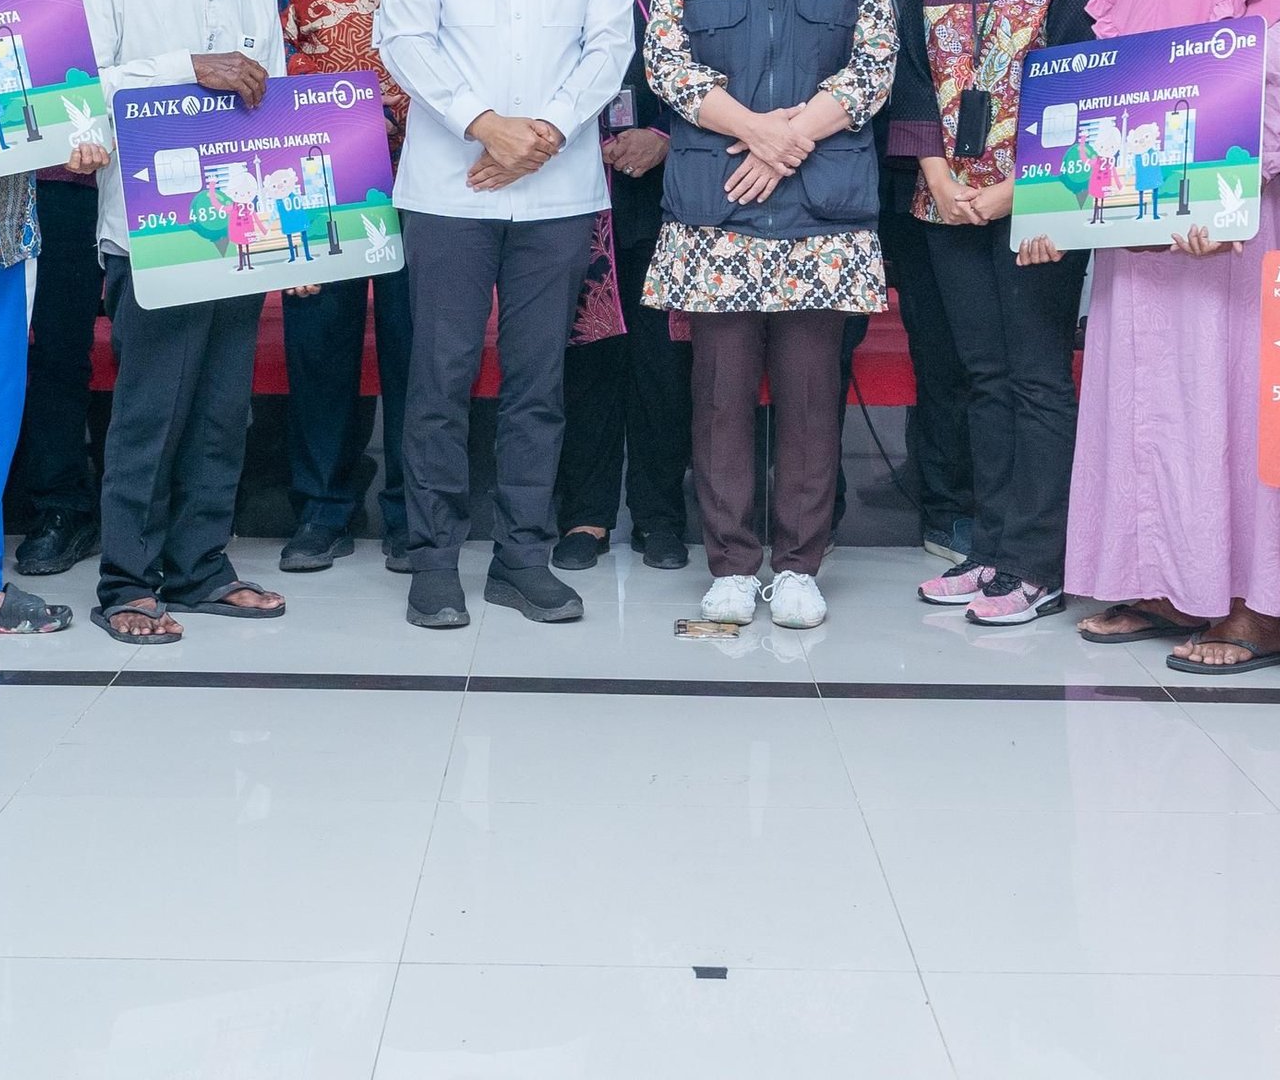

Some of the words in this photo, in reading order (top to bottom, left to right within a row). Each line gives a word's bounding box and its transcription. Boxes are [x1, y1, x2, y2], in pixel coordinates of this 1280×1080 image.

[1028, 57, 1071, 78] BANK
[1086, 50, 1118, 67] DKI
[125, 99, 182, 119] BANK
[201, 95, 236, 112] DKI
[1078, 95, 1113, 112] KARTU
[1113, 90, 1150, 106] LANSIA
[1151, 85, 1199, 102] JAKARTA
[199, 140, 238, 156] KARTU
[241, 136, 281, 152] LANSIA
[283, 132, 331, 148] JAKARTA
[1022, 163, 1052, 179] 5049
[1060, 158, 1091, 174] 4856
[137, 212, 178, 230] 5049
[188, 205, 227, 223] 4856
[1214, 210, 1249, 229] GPN
[364, 245, 396, 264] GPN
